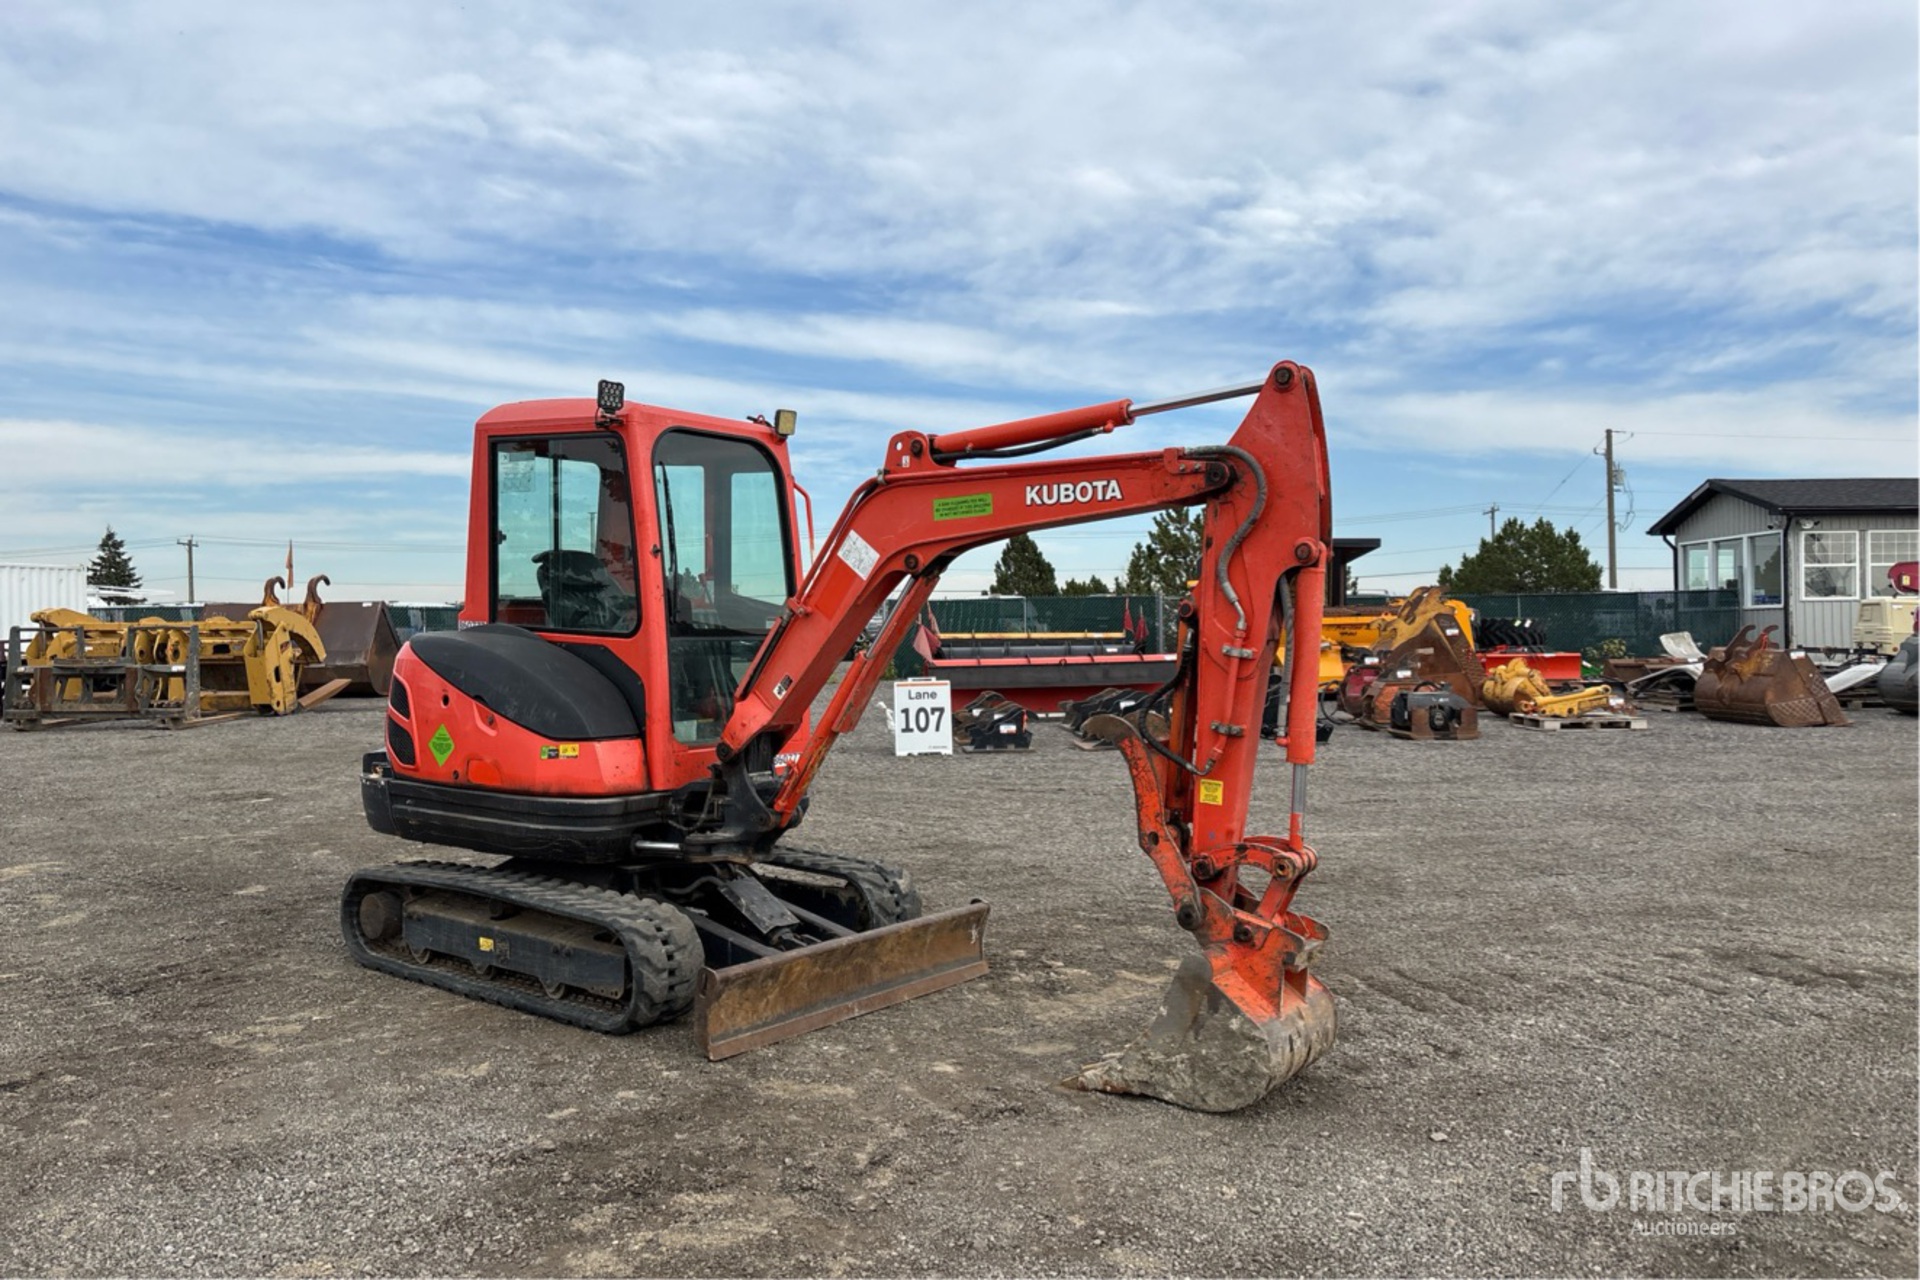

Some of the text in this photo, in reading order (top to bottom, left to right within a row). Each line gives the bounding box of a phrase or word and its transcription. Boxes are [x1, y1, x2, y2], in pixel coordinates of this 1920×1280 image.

[1025, 479, 1123, 506] KUBOTA
[907, 689, 938, 700] Lane
[900, 706, 945, 733] 107
